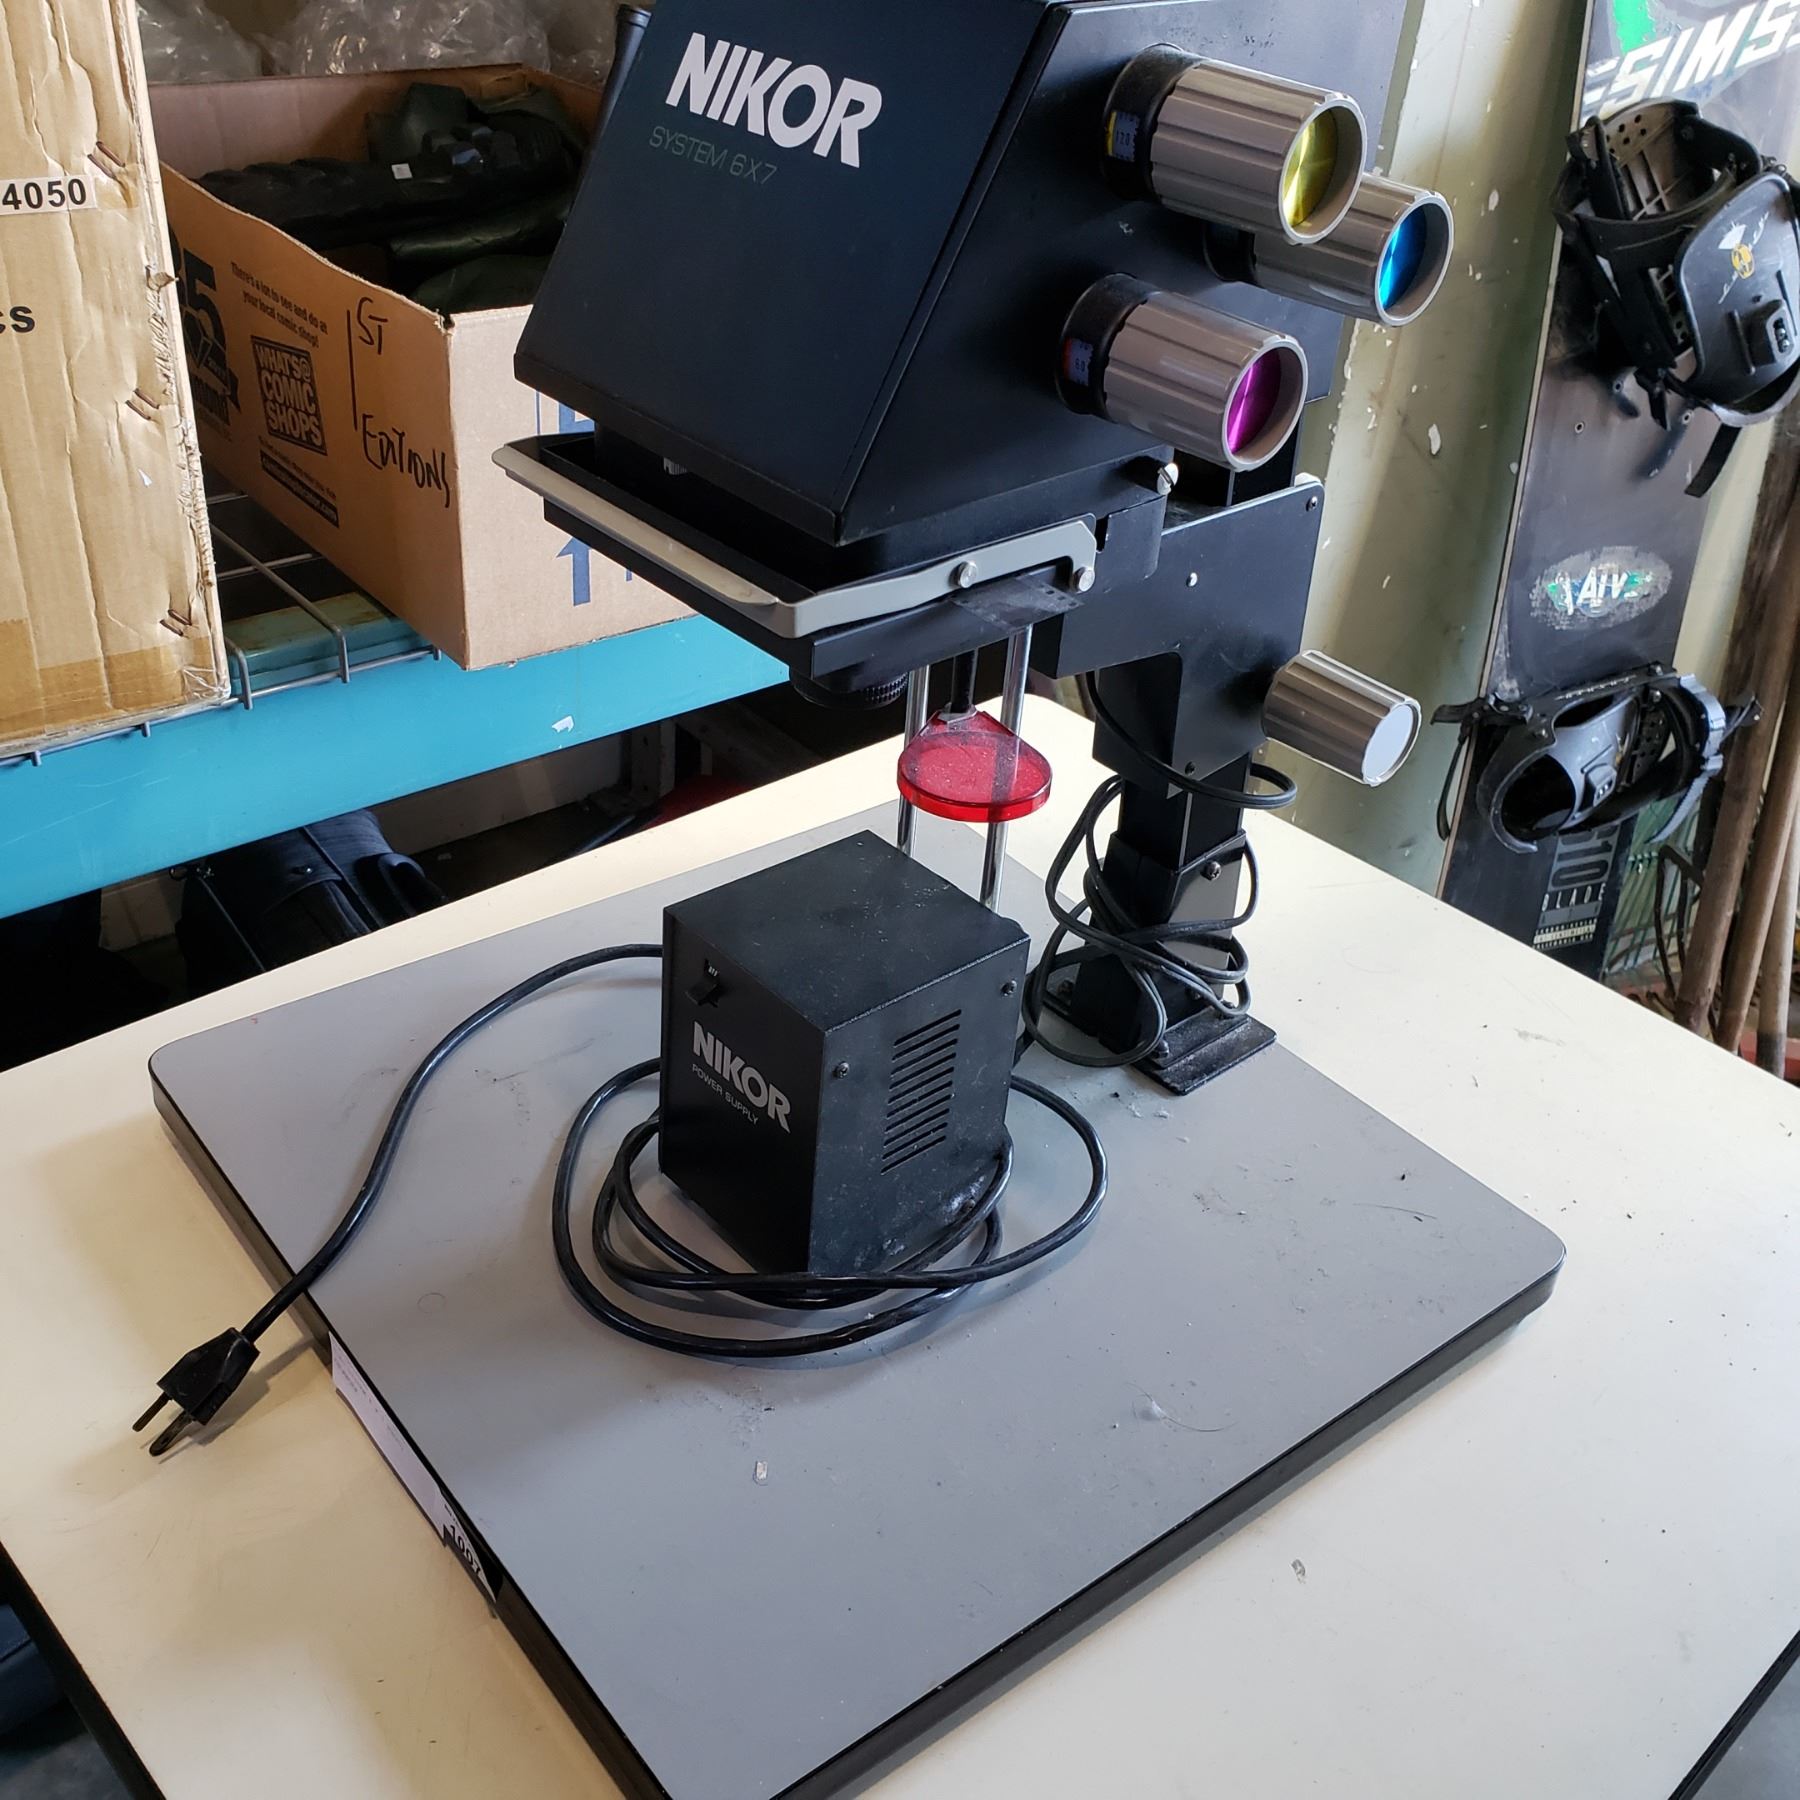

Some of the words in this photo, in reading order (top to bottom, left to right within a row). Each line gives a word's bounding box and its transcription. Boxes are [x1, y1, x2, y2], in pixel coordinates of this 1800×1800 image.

[665, 31, 883, 168] NIKOR
[649, 125, 728, 170] SYSTEM
[729, 154, 779, 185] 6X7
[260, 370, 317, 415] COMIC
[265, 400, 323, 446] SHOPS
[692, 1021, 791, 1134] NIKOR
[692, 1063, 723, 1097] POWER
[725, 1091, 760, 1125] SUPPLY
